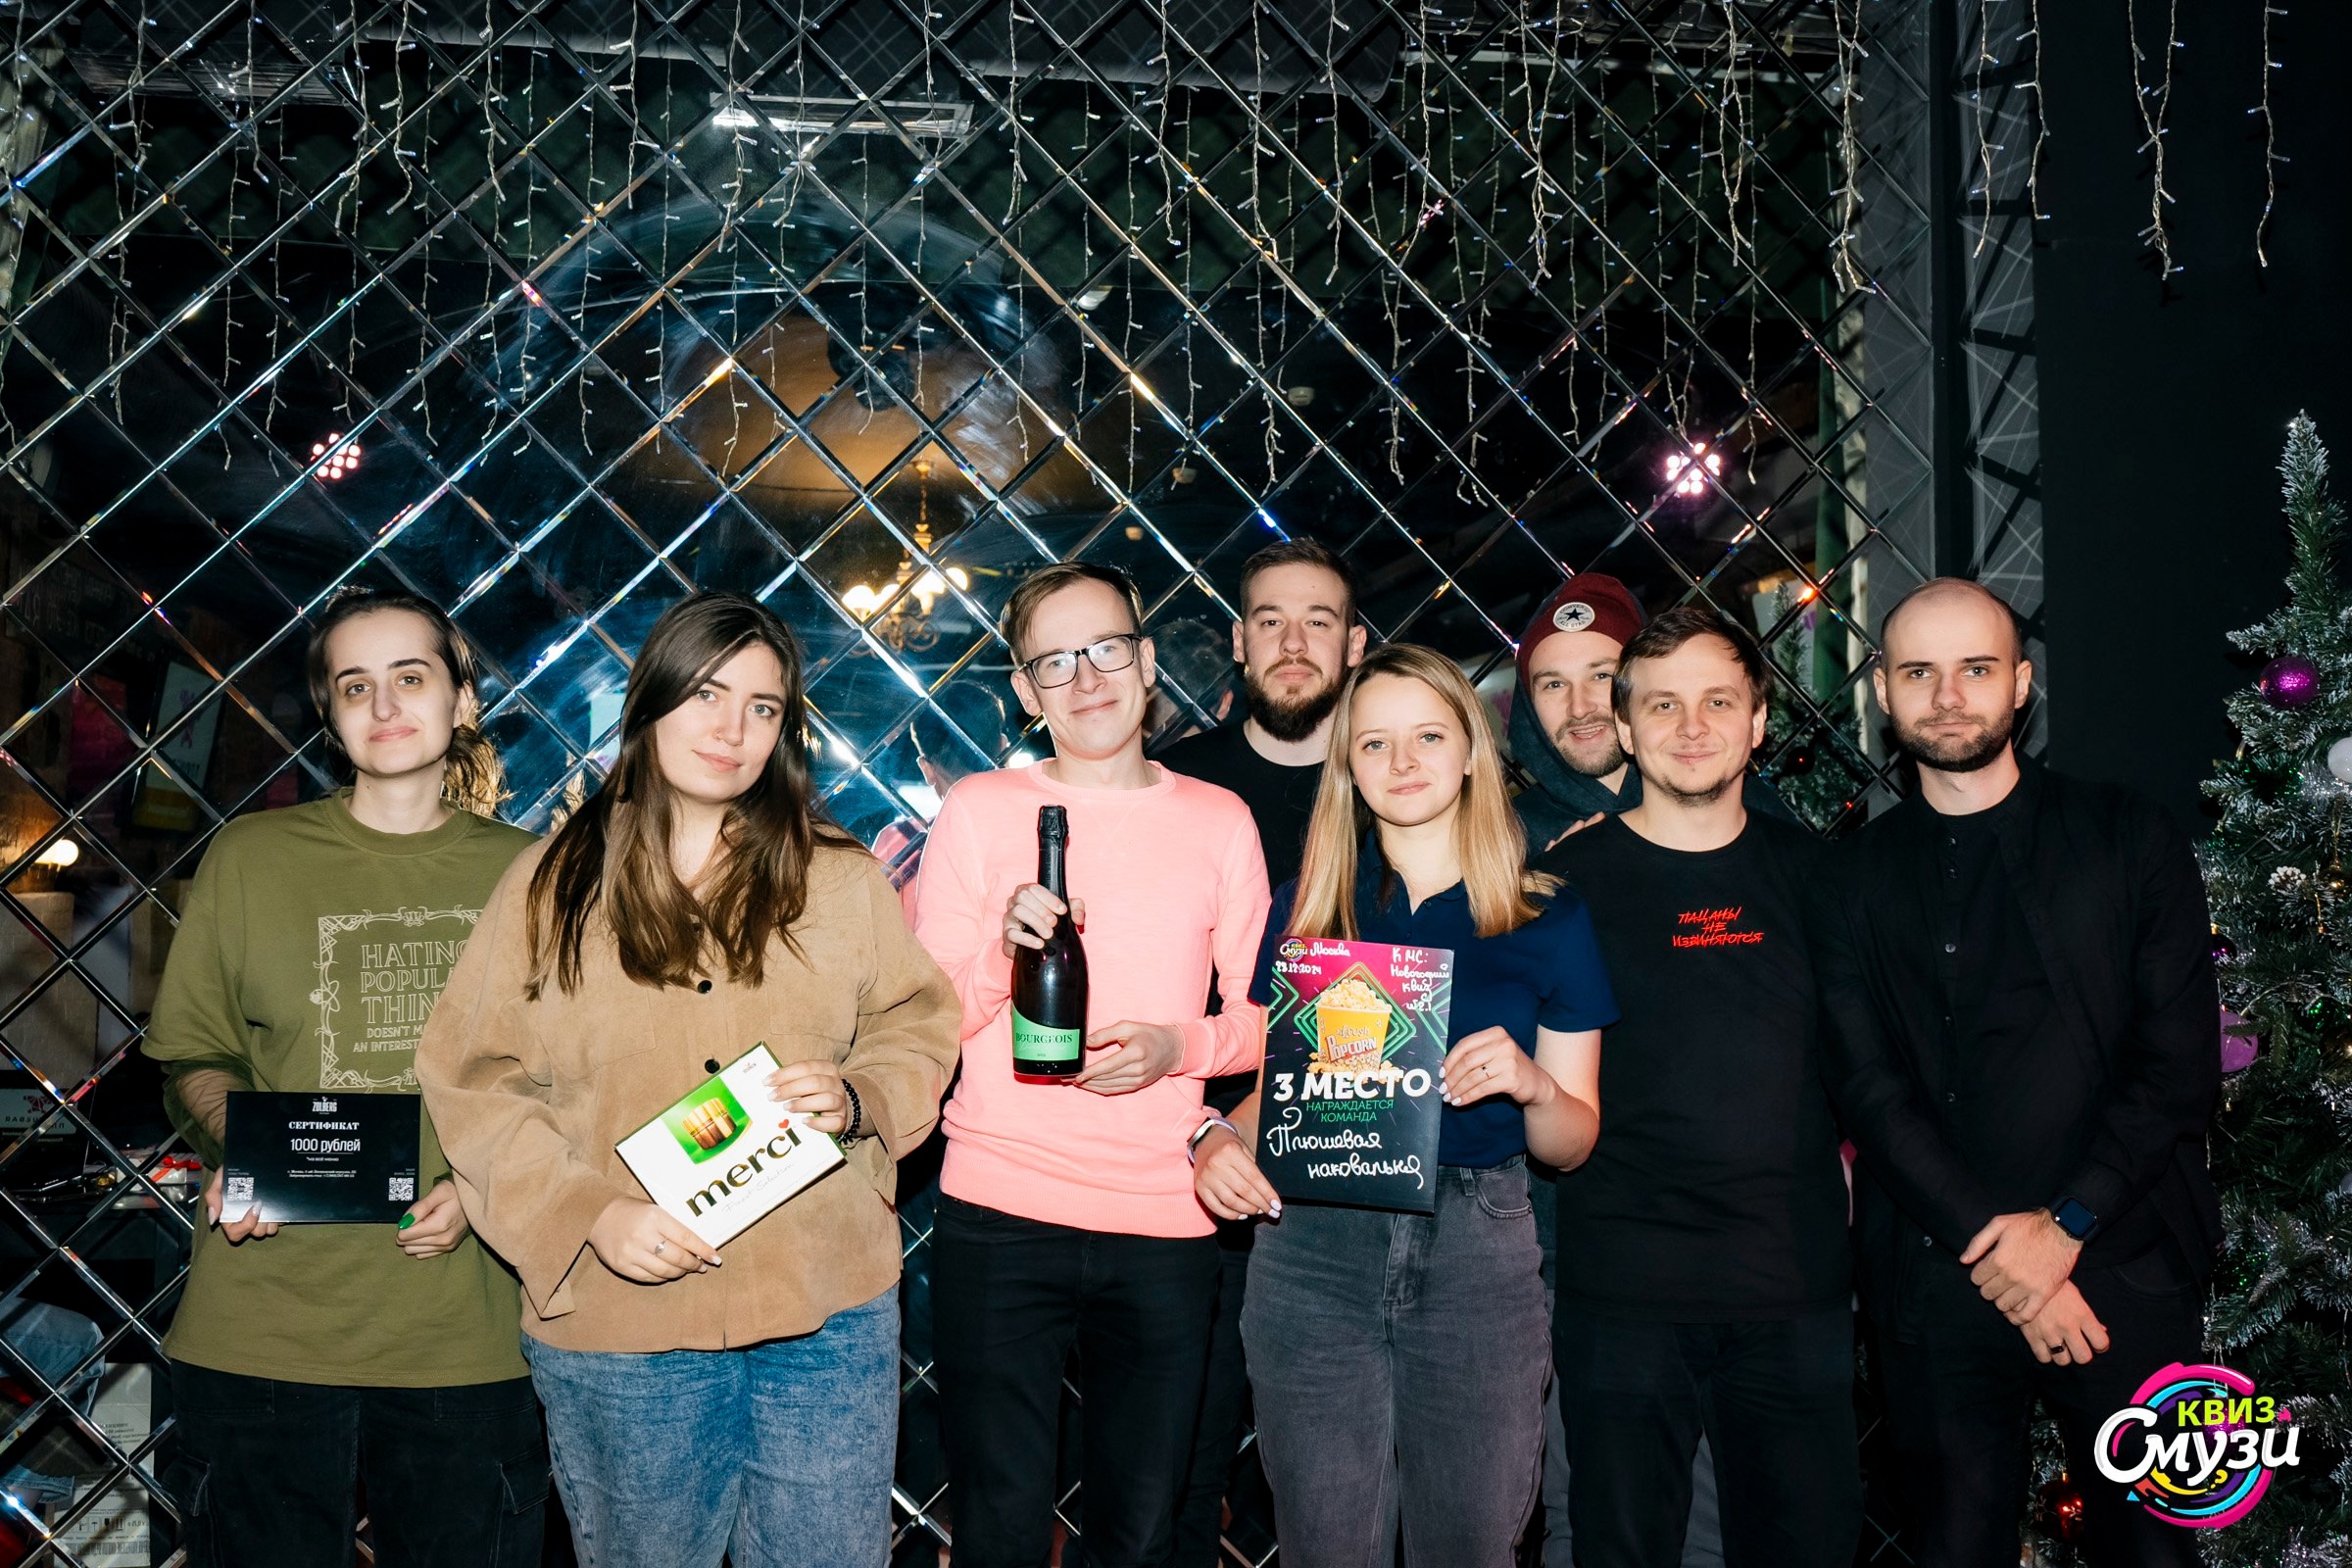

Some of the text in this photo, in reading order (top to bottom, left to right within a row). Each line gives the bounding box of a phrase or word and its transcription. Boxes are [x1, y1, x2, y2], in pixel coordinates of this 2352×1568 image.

[1678, 906, 1741, 924] ПАЦАНЫ
[1701, 922, 1727, 933] НЕ
[1672, 932, 1764, 948] ИЗВИНЯЮТСЯ
[1015, 1033, 1073, 1044] BOURGEOIS
[353, 1042, 368, 1053] AN
[1273, 1068, 1431, 1102] 3 МЕСТО
[312, 1101, 338, 1112] ZOLBERG
[1306, 1099, 1394, 1111] НАГРАЖДАЕТСЯ
[1321, 1111, 1377, 1122] КОМАНДА
[288, 1121, 360, 1130] СЕРТИФИКАТ
[290, 1138, 361, 1153] 1000 рублей
[686, 1121, 802, 1217] merci
